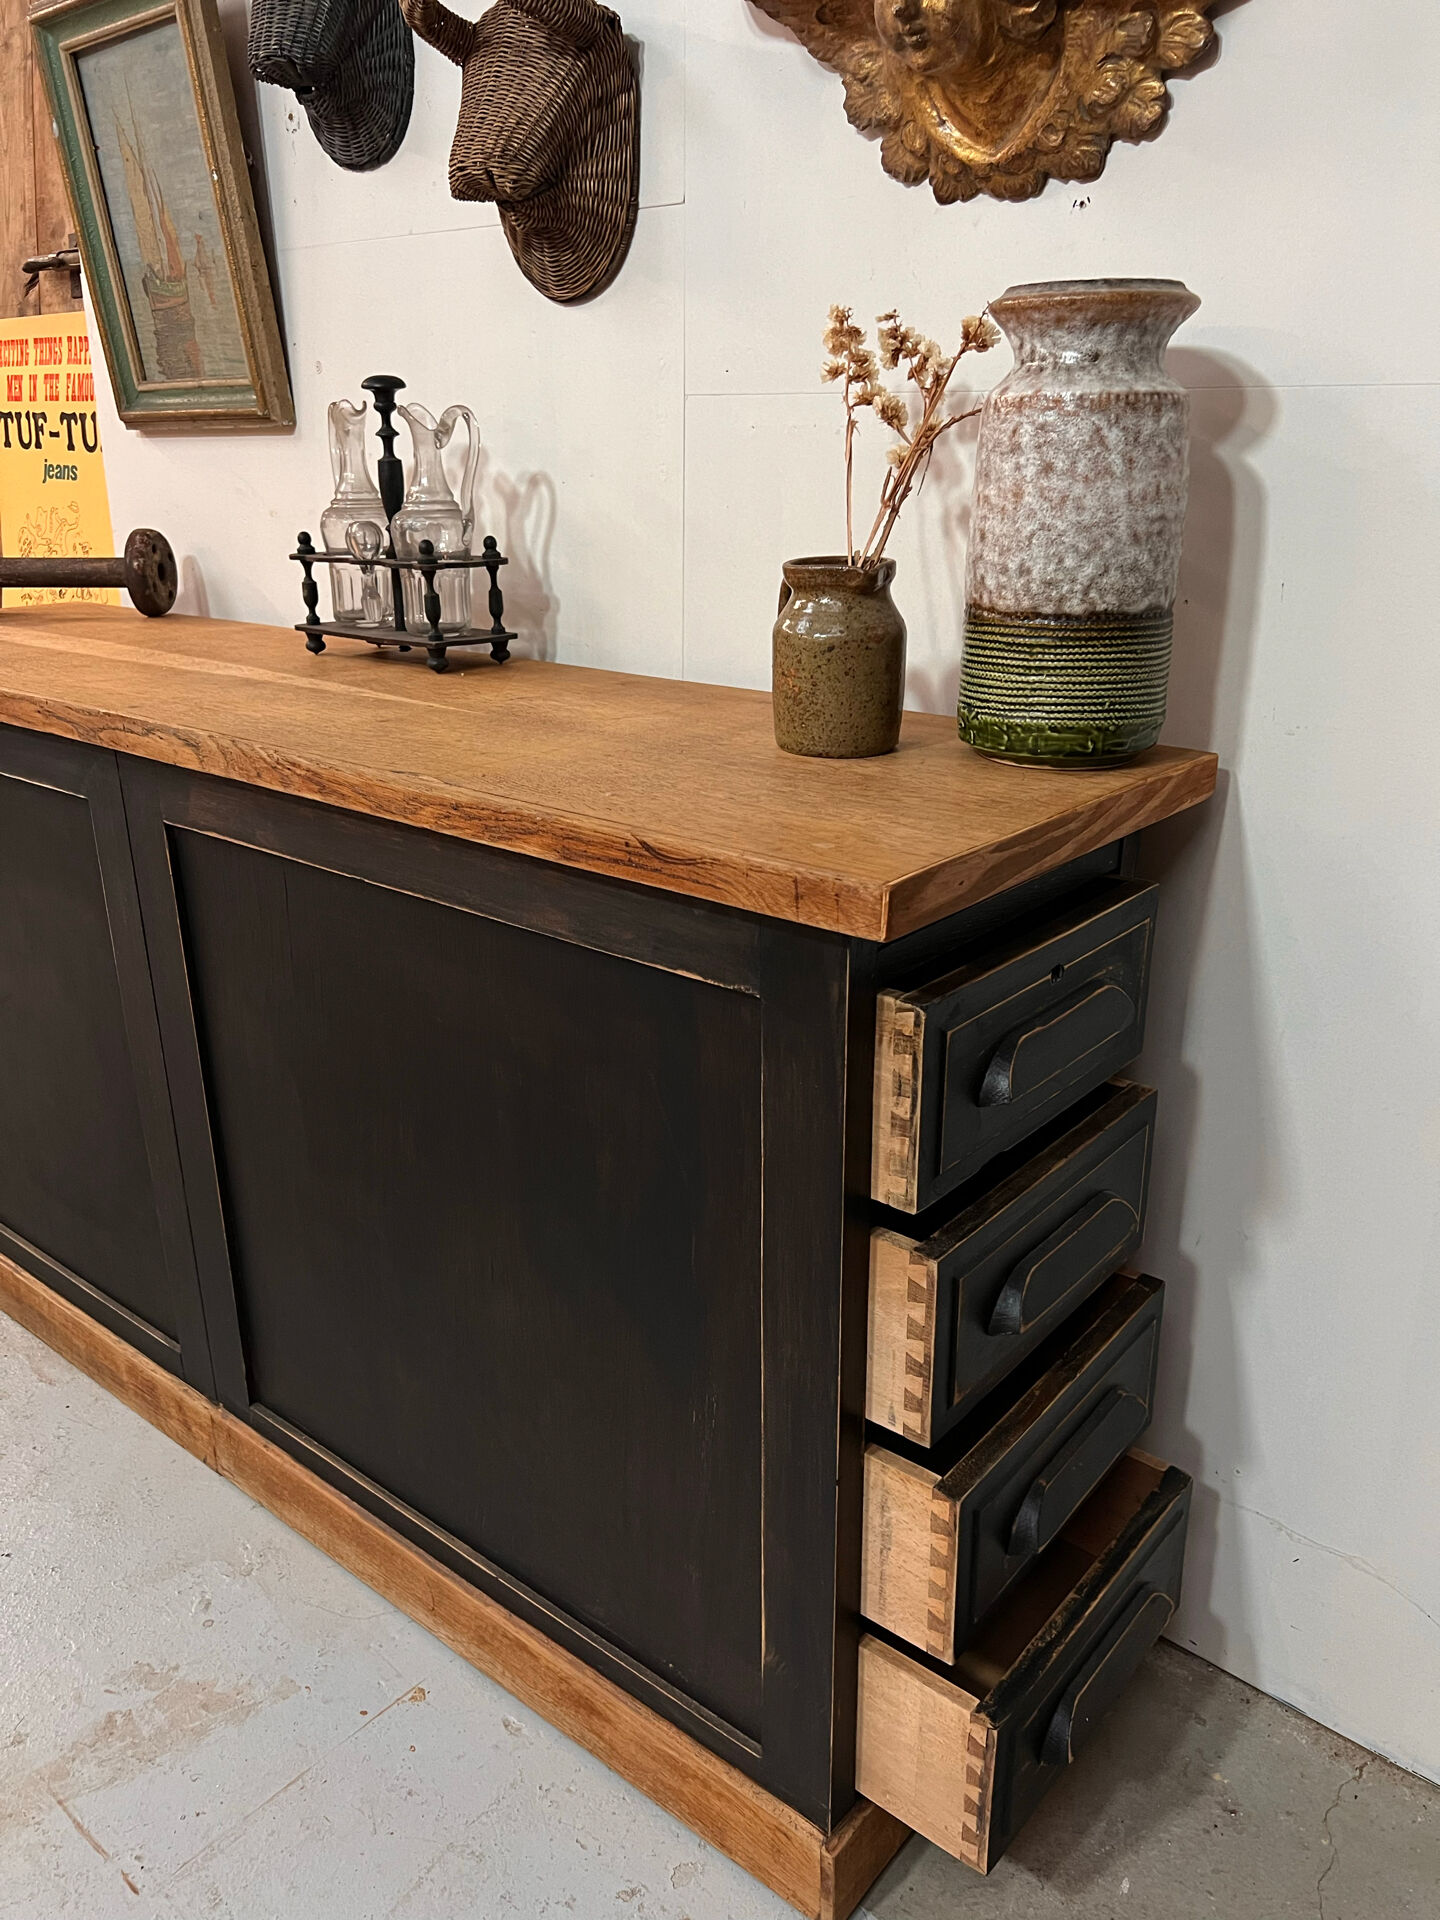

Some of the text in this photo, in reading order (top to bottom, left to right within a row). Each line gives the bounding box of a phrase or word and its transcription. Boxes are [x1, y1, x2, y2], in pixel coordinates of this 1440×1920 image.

[33, 337, 62, 366] THINGS
[67, 336, 91, 365] HAPP
[7, 373, 96, 402] MEN IN THE FAMOU
[0, 410, 102, 453] TUF-TU
[42, 458, 78, 484] jeans
